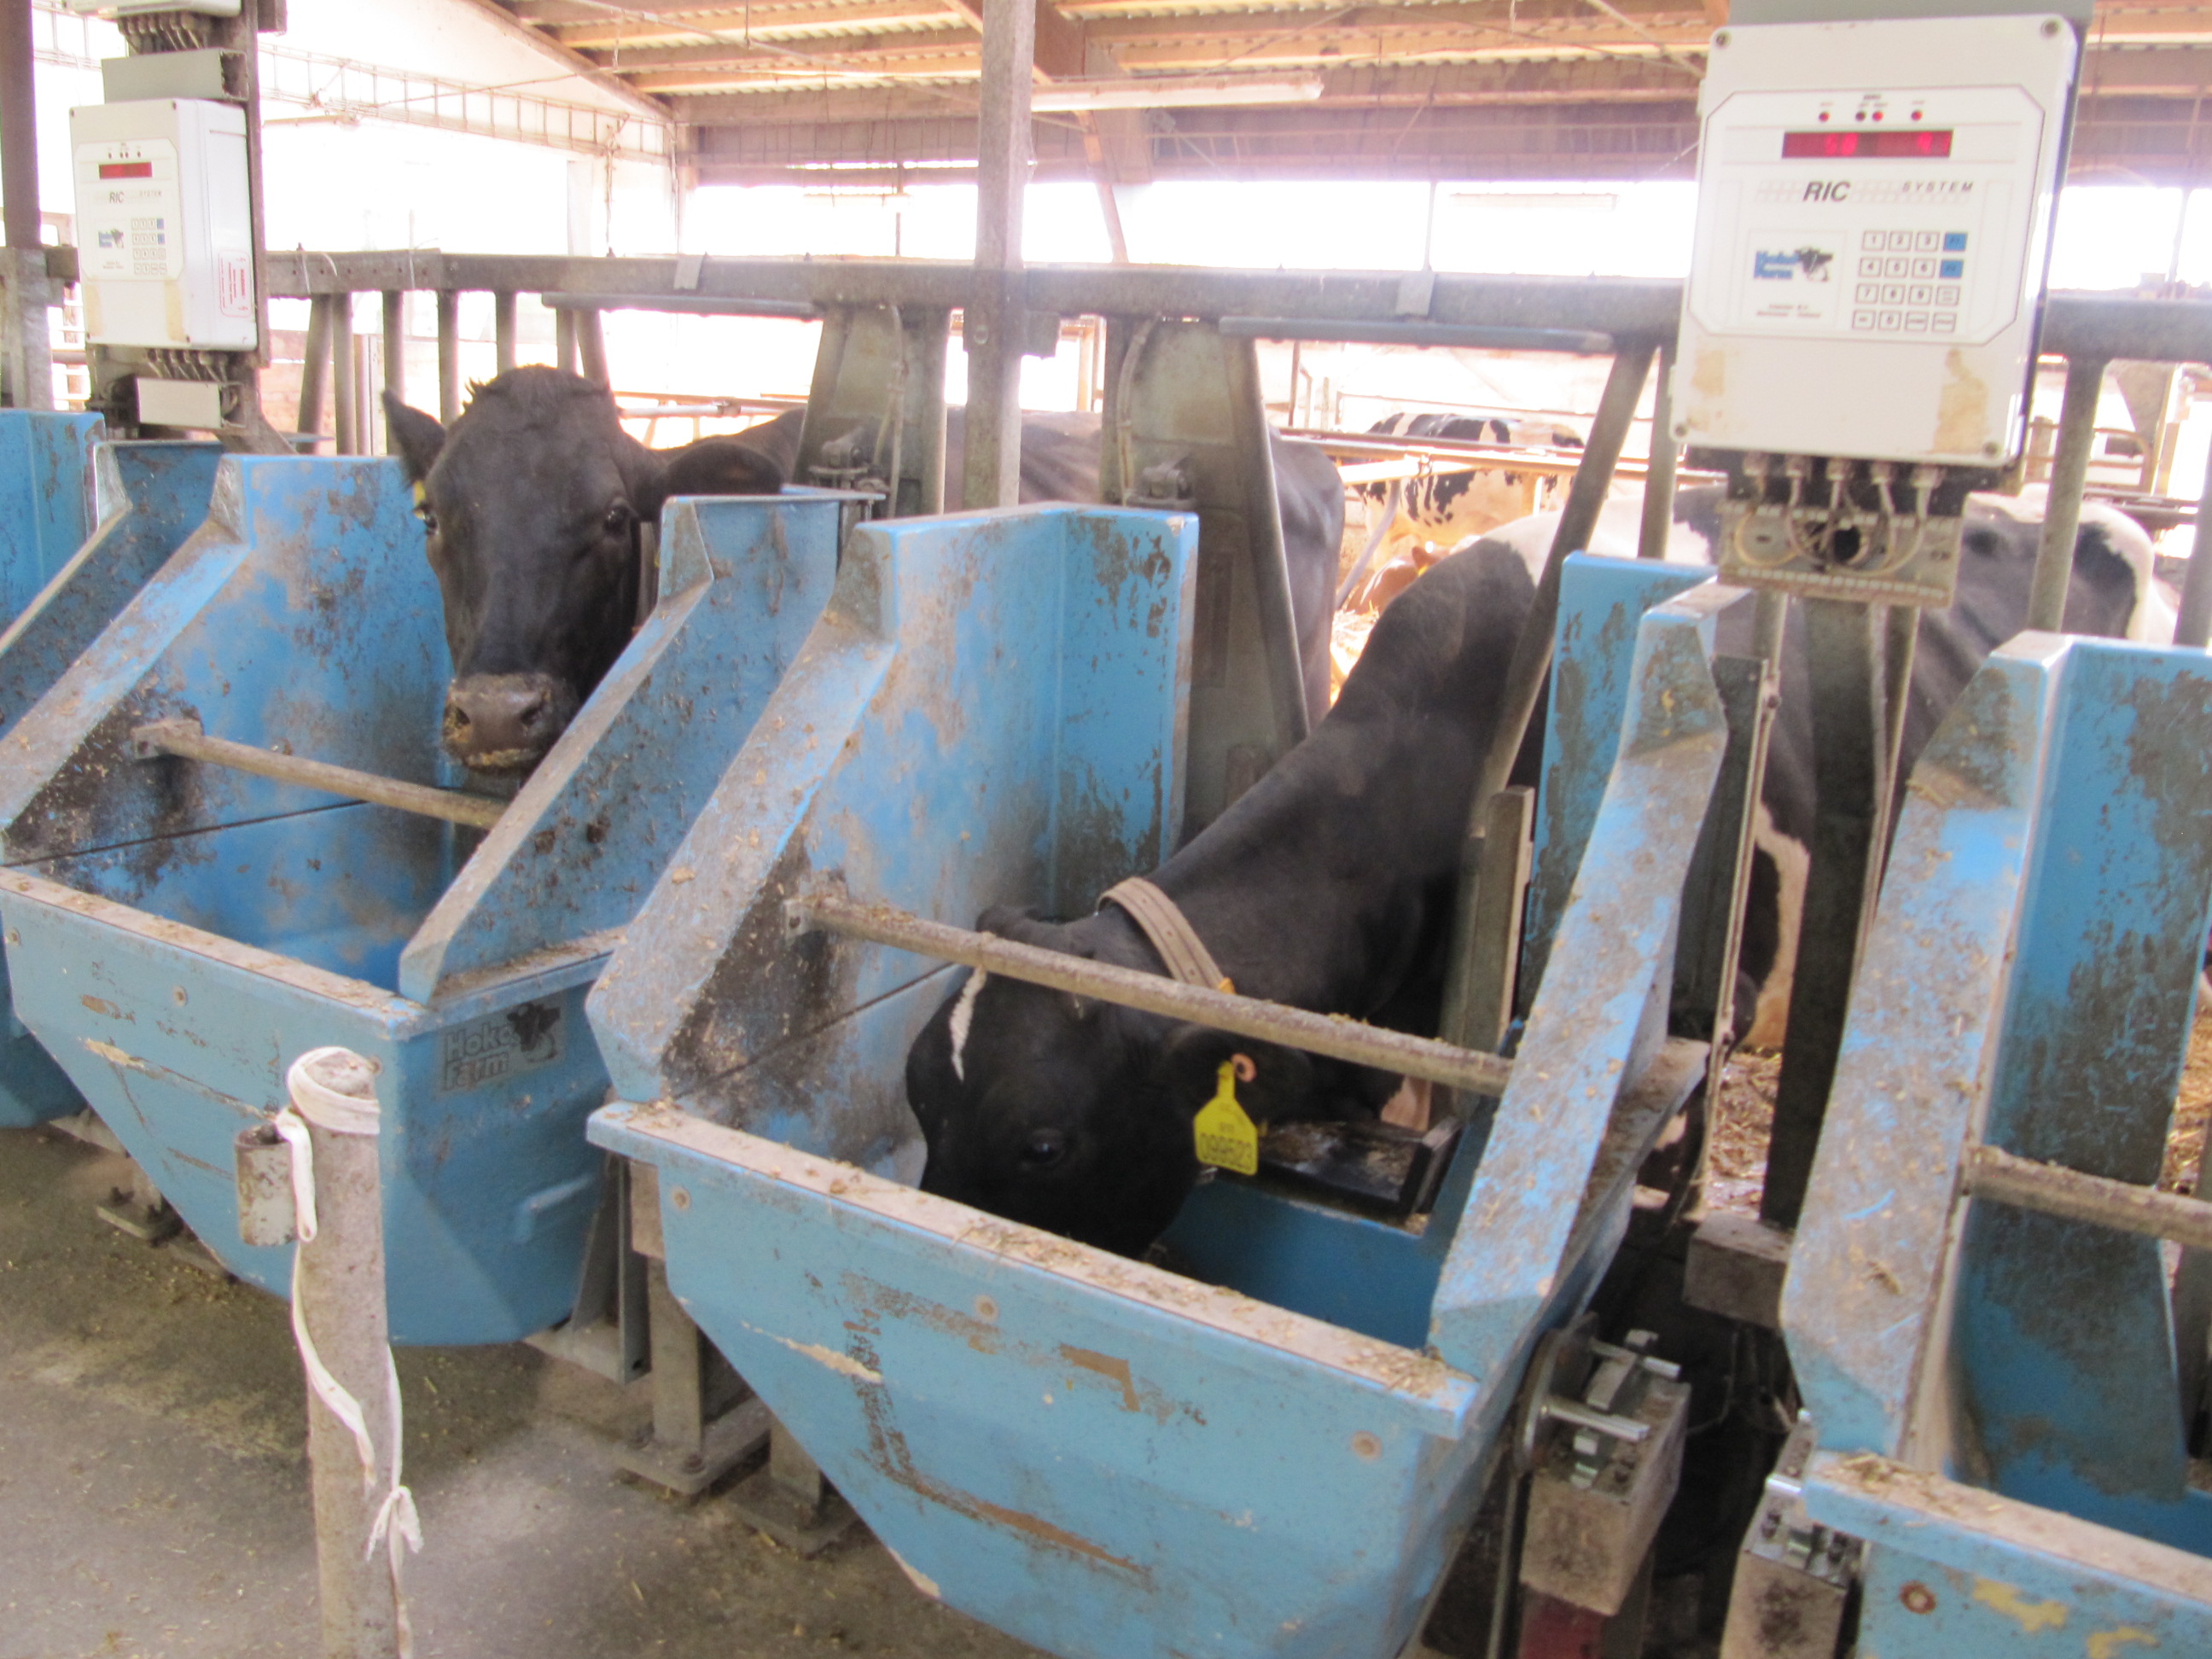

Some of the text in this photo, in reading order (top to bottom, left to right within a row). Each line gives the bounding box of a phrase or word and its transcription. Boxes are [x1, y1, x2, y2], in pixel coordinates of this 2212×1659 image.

[109, 191, 125, 203] RIC
[1803, 181, 1974, 201] RIC SYSTEM
[445, 1022, 513, 1063] Hoko
[443, 1051, 509, 1090] Farm
